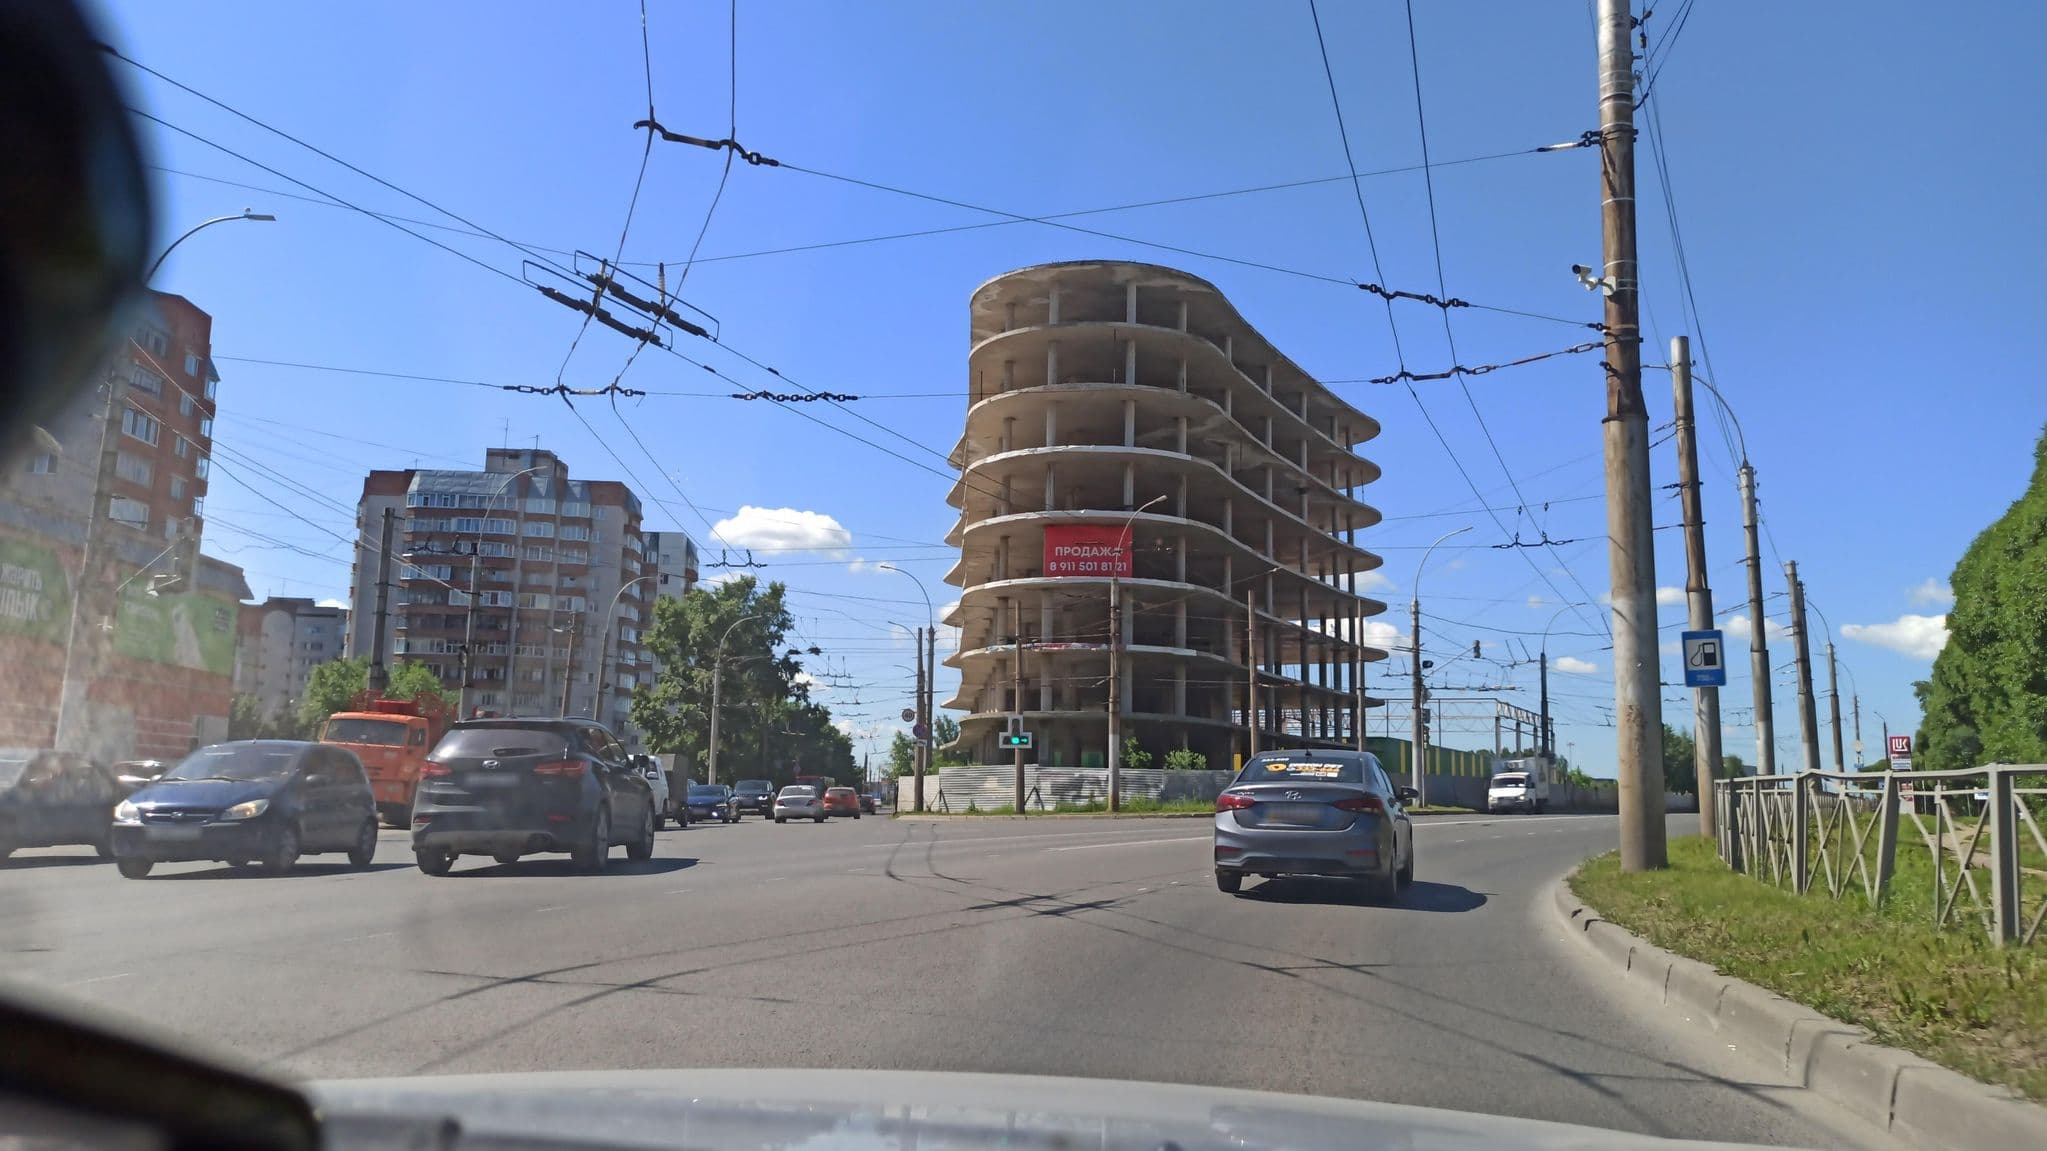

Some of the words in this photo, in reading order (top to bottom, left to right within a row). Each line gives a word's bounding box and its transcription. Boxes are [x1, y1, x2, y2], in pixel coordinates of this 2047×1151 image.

[1050, 561, 1056, 571] 8
[1060, 561, 1075, 571] 911
[1079, 561, 1098, 571] 501
[1101, 561, 1113, 571] 81
